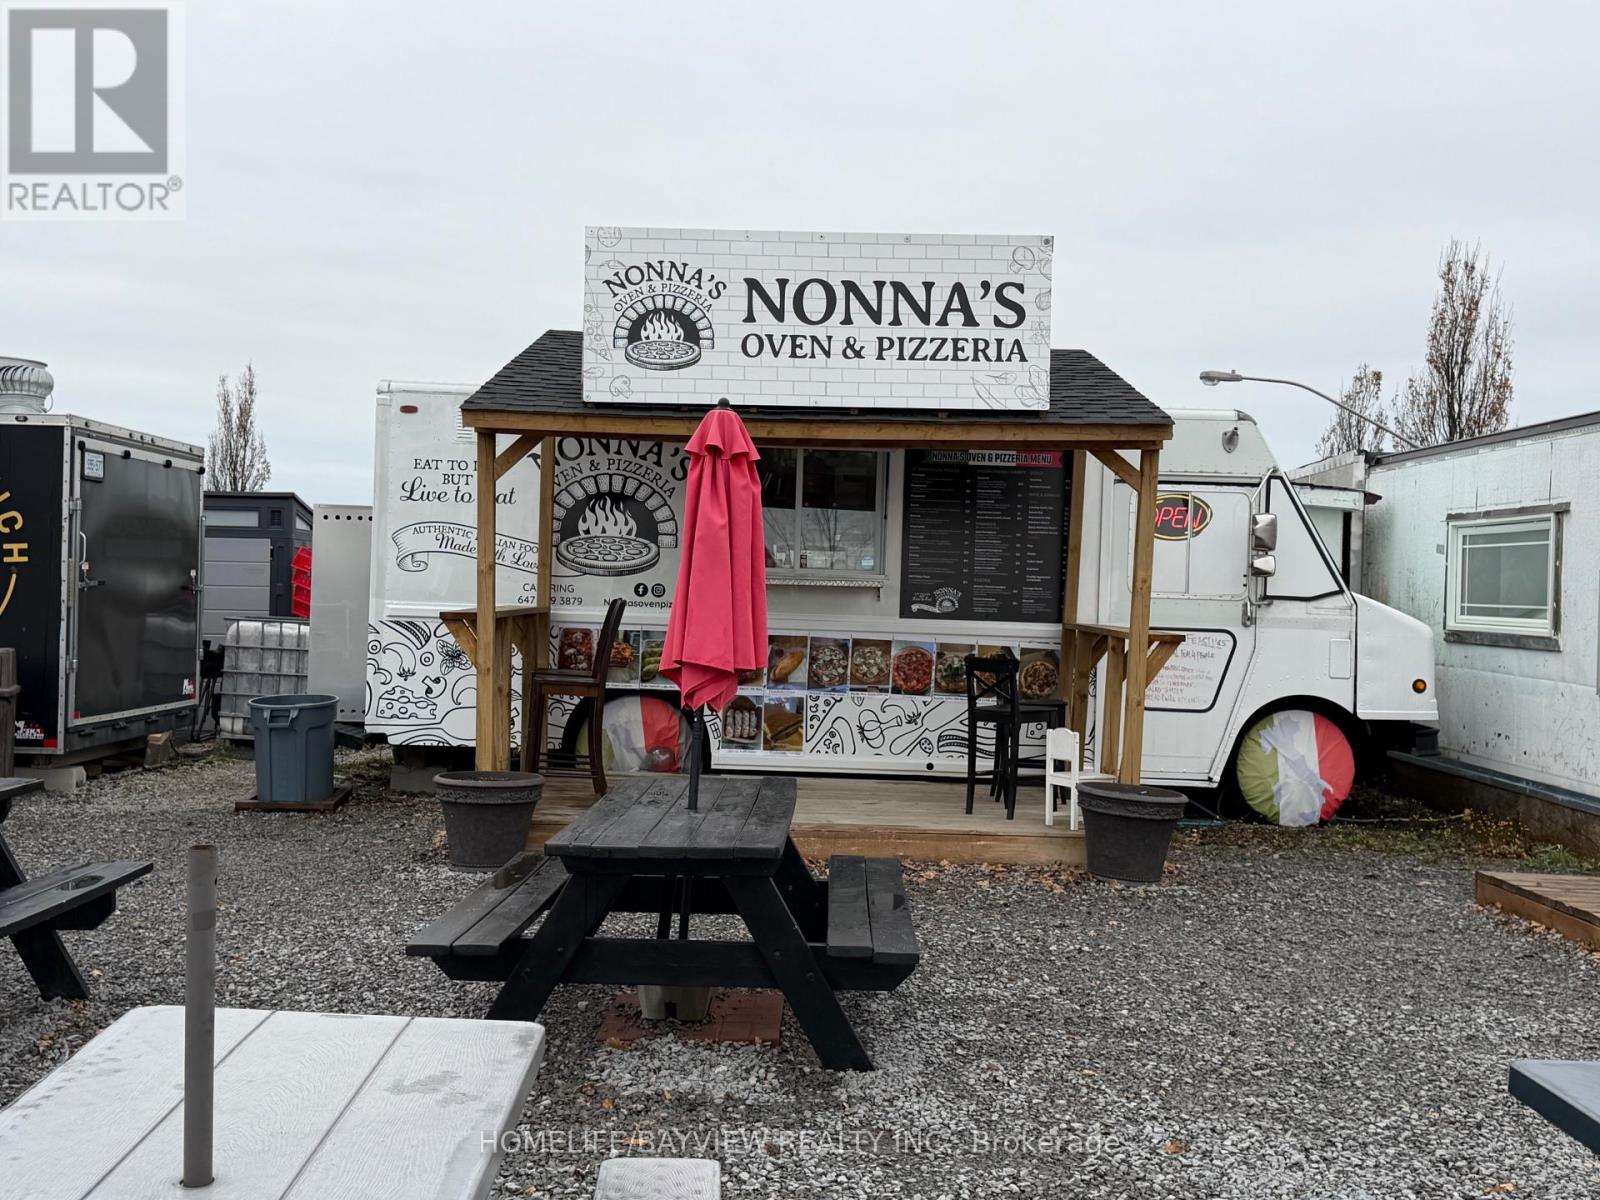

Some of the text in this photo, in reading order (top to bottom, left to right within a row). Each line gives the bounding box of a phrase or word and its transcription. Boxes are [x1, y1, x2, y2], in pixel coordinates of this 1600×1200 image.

[602, 260, 727, 299] NONNA'S
[614, 283, 712, 313] OVEN & PIZZERIA
[742, 277, 1026, 328] NONNA'S
[741, 333, 1028, 362] OVEN & PIZZERIA
[414, 459, 443, 470] EAT
[447, 460, 468, 471] TO
[967, 452, 986, 462] OVEN
[1030, 454, 1051, 464] MENU
[442, 474, 474, 485] BUT
[554, 458, 676, 498] VEN & PIZZERIA
[400, 476, 516, 504] Live to at
[1154, 506, 1204, 528] PEN
[412, 525, 473, 539] AUTHENTIC
[435, 533, 476, 554] Made
[519, 543, 539, 554] FOO
[511, 552, 538, 569] Lov
[518, 596, 535, 604] 647
[560, 597, 583, 606] 3879
